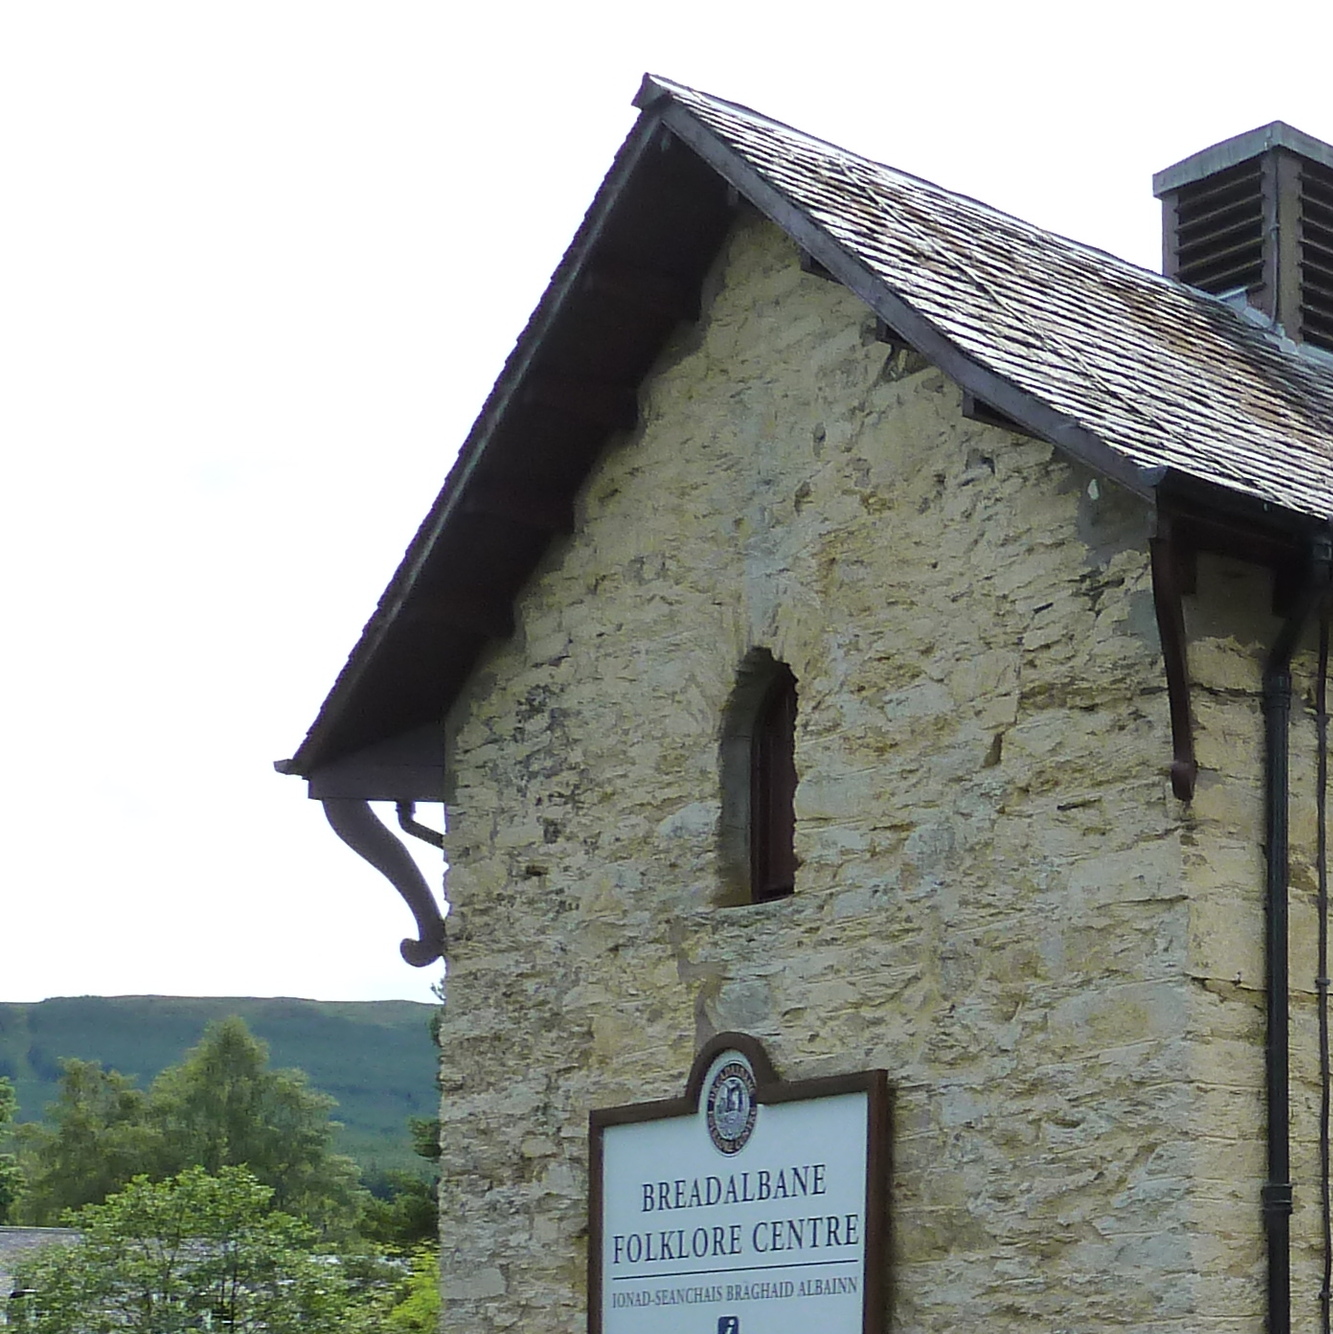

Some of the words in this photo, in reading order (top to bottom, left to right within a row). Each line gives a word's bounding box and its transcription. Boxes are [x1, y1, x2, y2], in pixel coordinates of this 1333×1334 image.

[641, 1164, 827, 1213] BREADALBANE
[612, 1225, 743, 1264] FOLKLORE
[752, 1214, 859, 1253] CENTRE
[612, 1285, 723, 1309] IONAD-SEANCHAIS
[799, 1276, 859, 1296] ALBAINN
